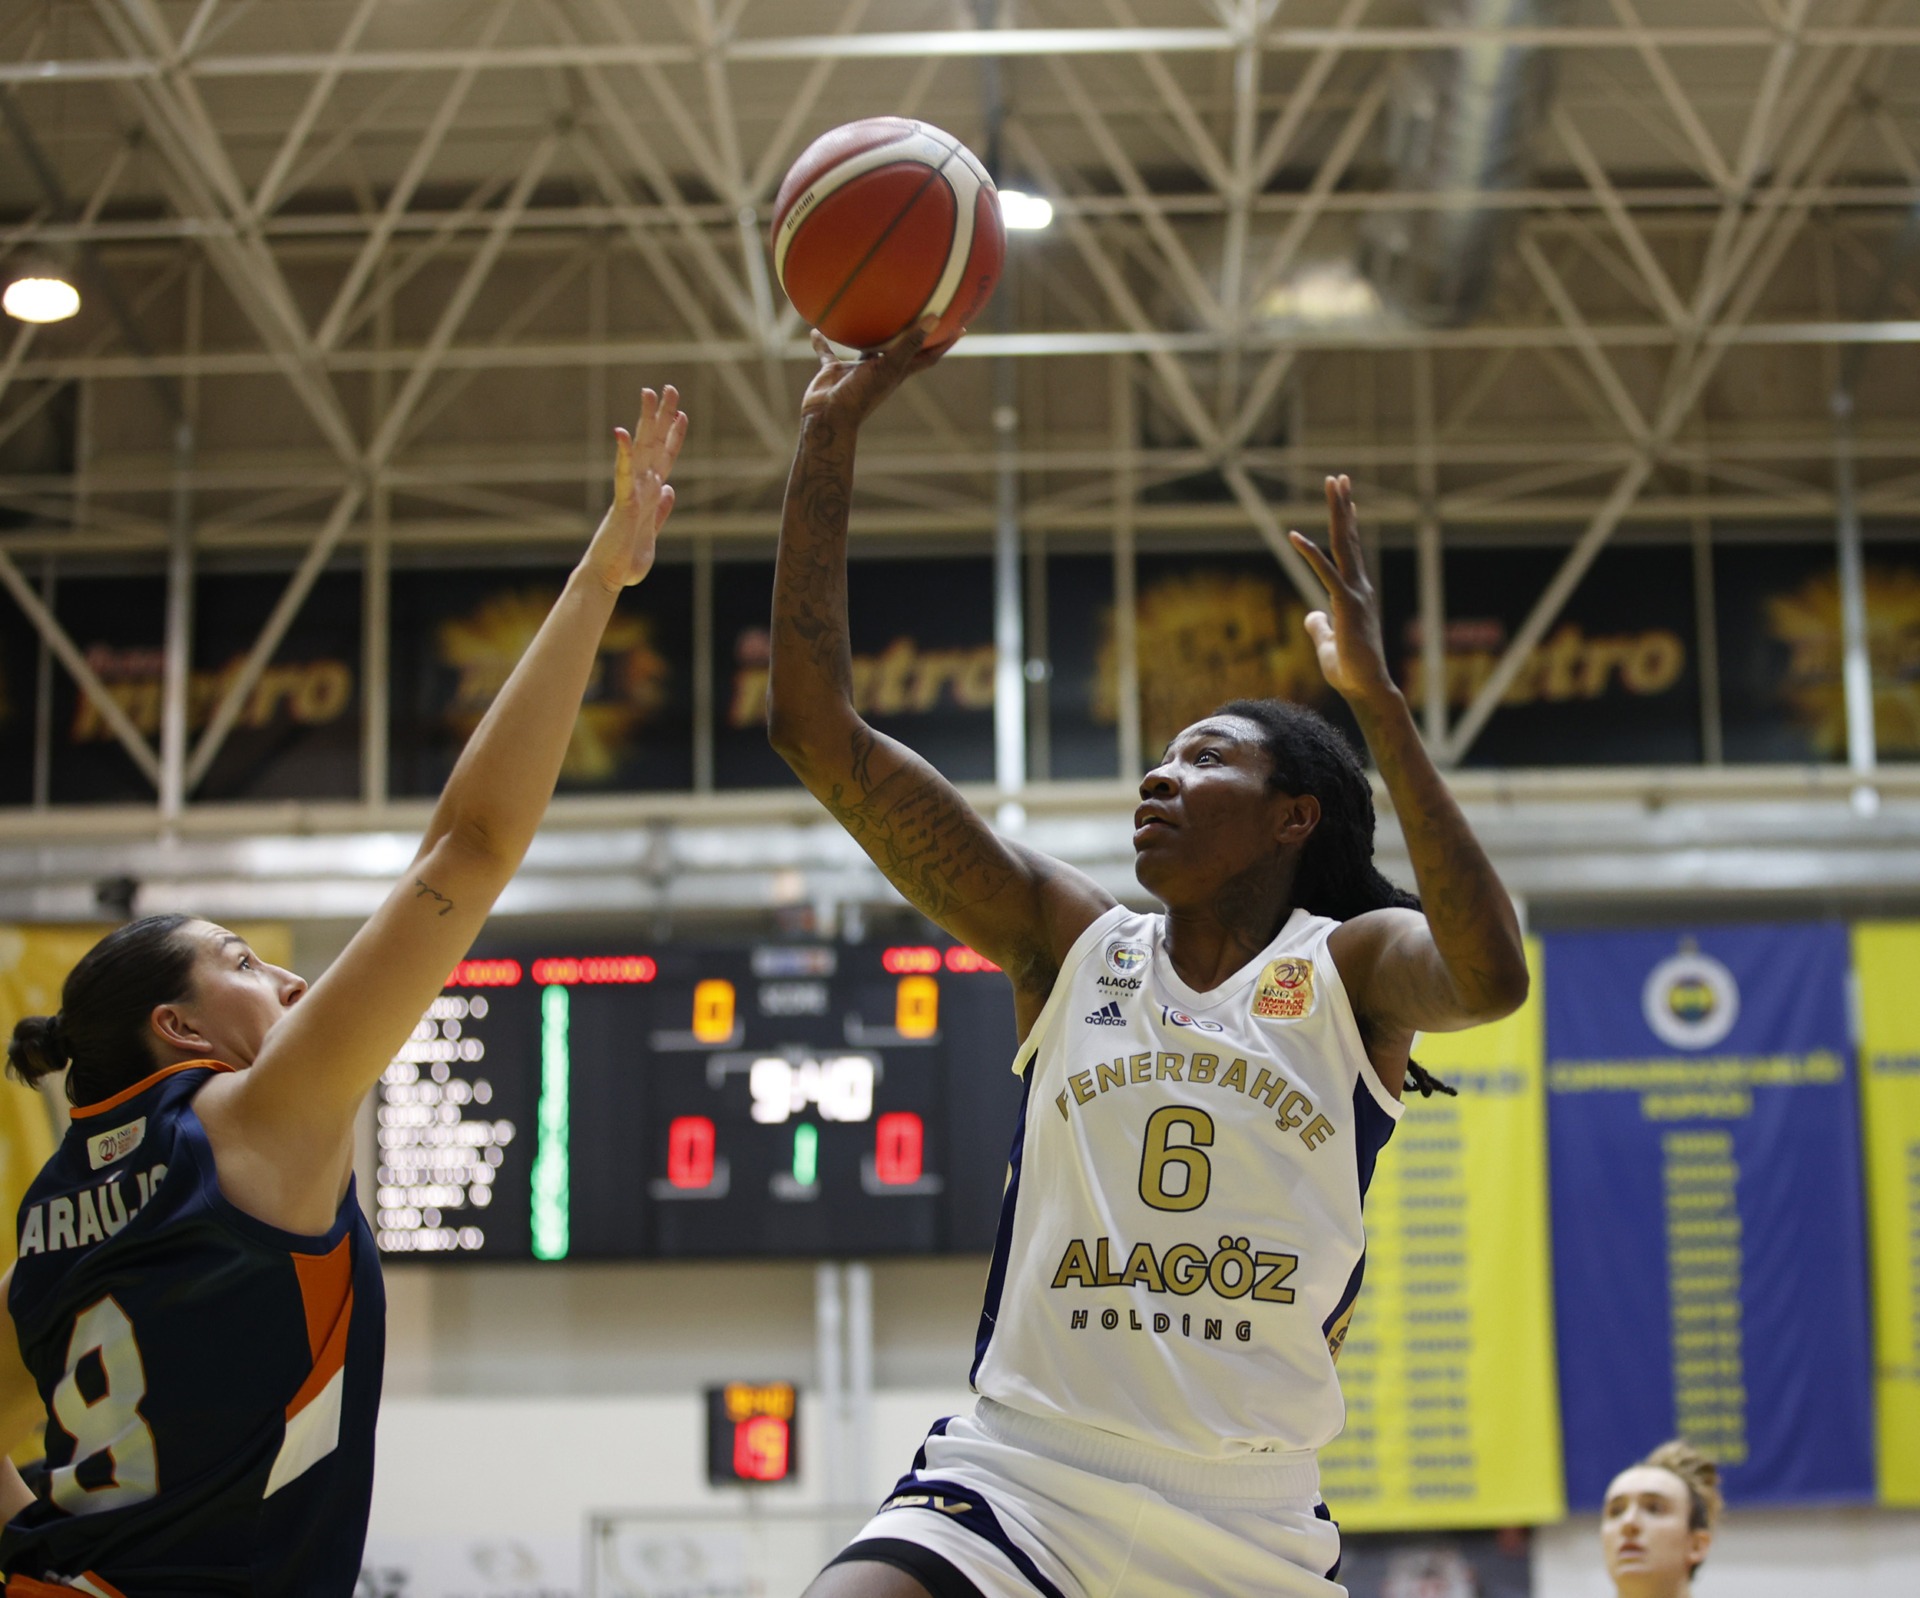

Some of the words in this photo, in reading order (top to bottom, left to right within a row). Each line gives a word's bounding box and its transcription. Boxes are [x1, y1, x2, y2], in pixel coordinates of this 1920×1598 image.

[1096, 975, 1142, 990] ALAGÖZ
[1084, 1015, 1127, 1027] adidas
[1055, 1051, 1336, 1151] FENERBAHÇE
[667, 1114, 716, 1190] 0
[875, 1111, 925, 1186] 0
[1138, 1104, 1215, 1213] 6
[1050, 1235, 1299, 1304] ALAGÖZ
[50, 1293, 161, 1518] 8
